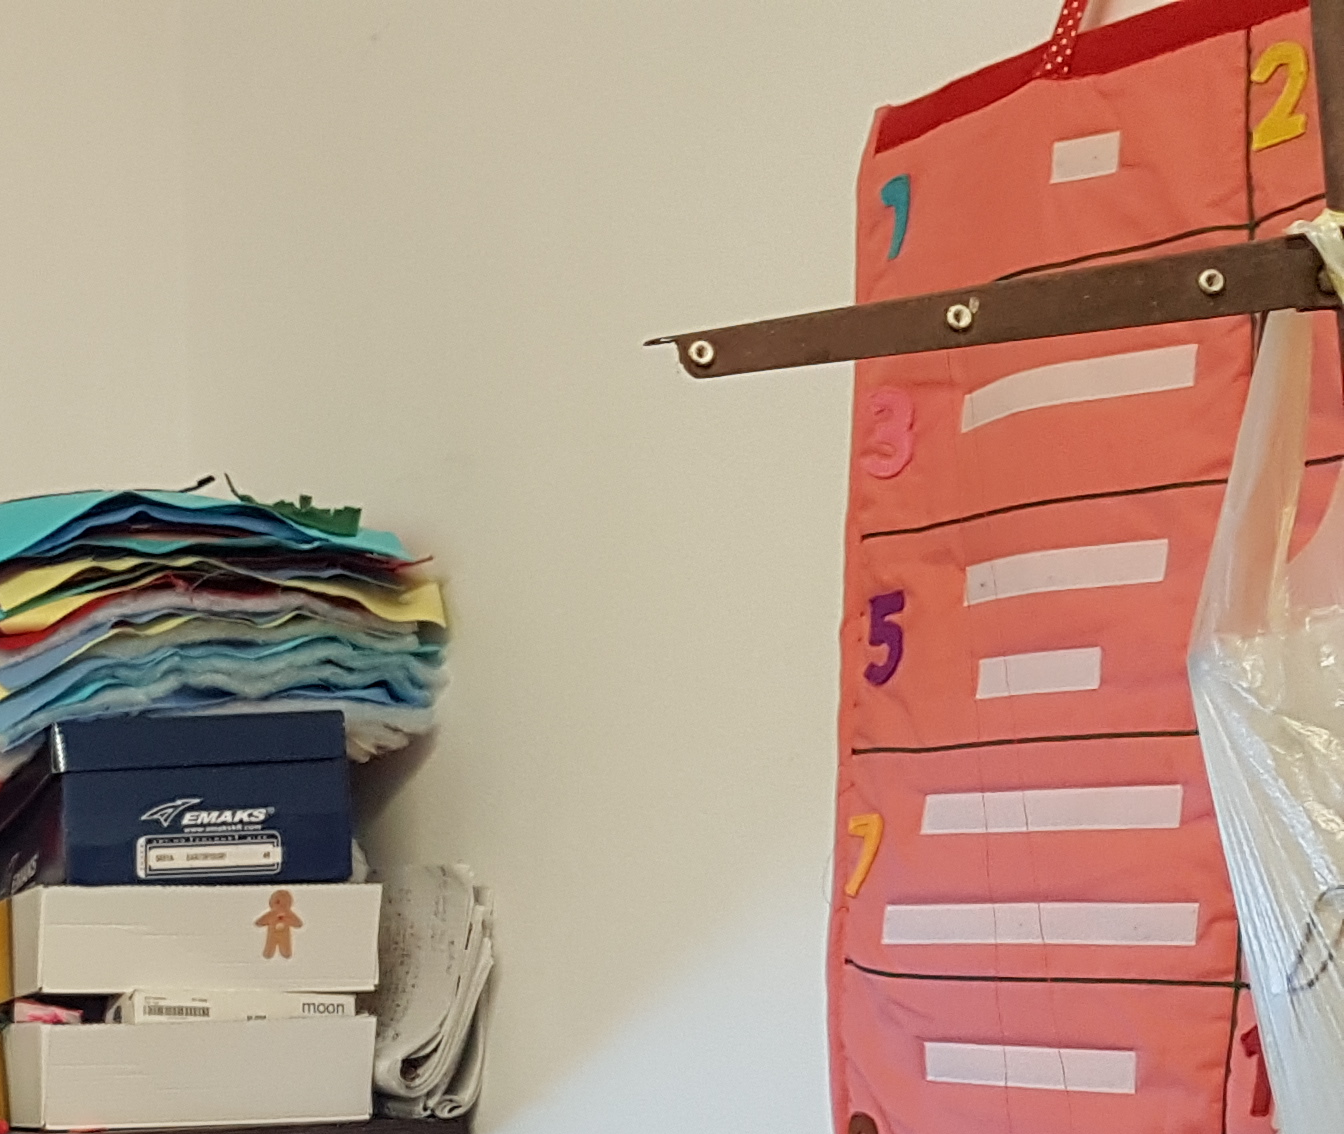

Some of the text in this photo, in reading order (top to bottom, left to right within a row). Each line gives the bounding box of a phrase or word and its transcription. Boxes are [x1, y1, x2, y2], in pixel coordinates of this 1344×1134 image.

[1249, 41, 1310, 152] 2
[861, 386, 914, 479] 3
[863, 589, 906, 687] 5
[181, 808, 267, 826] EMAKS
[845, 812, 884, 897] 7
[301, 1001, 345, 1015] moon
